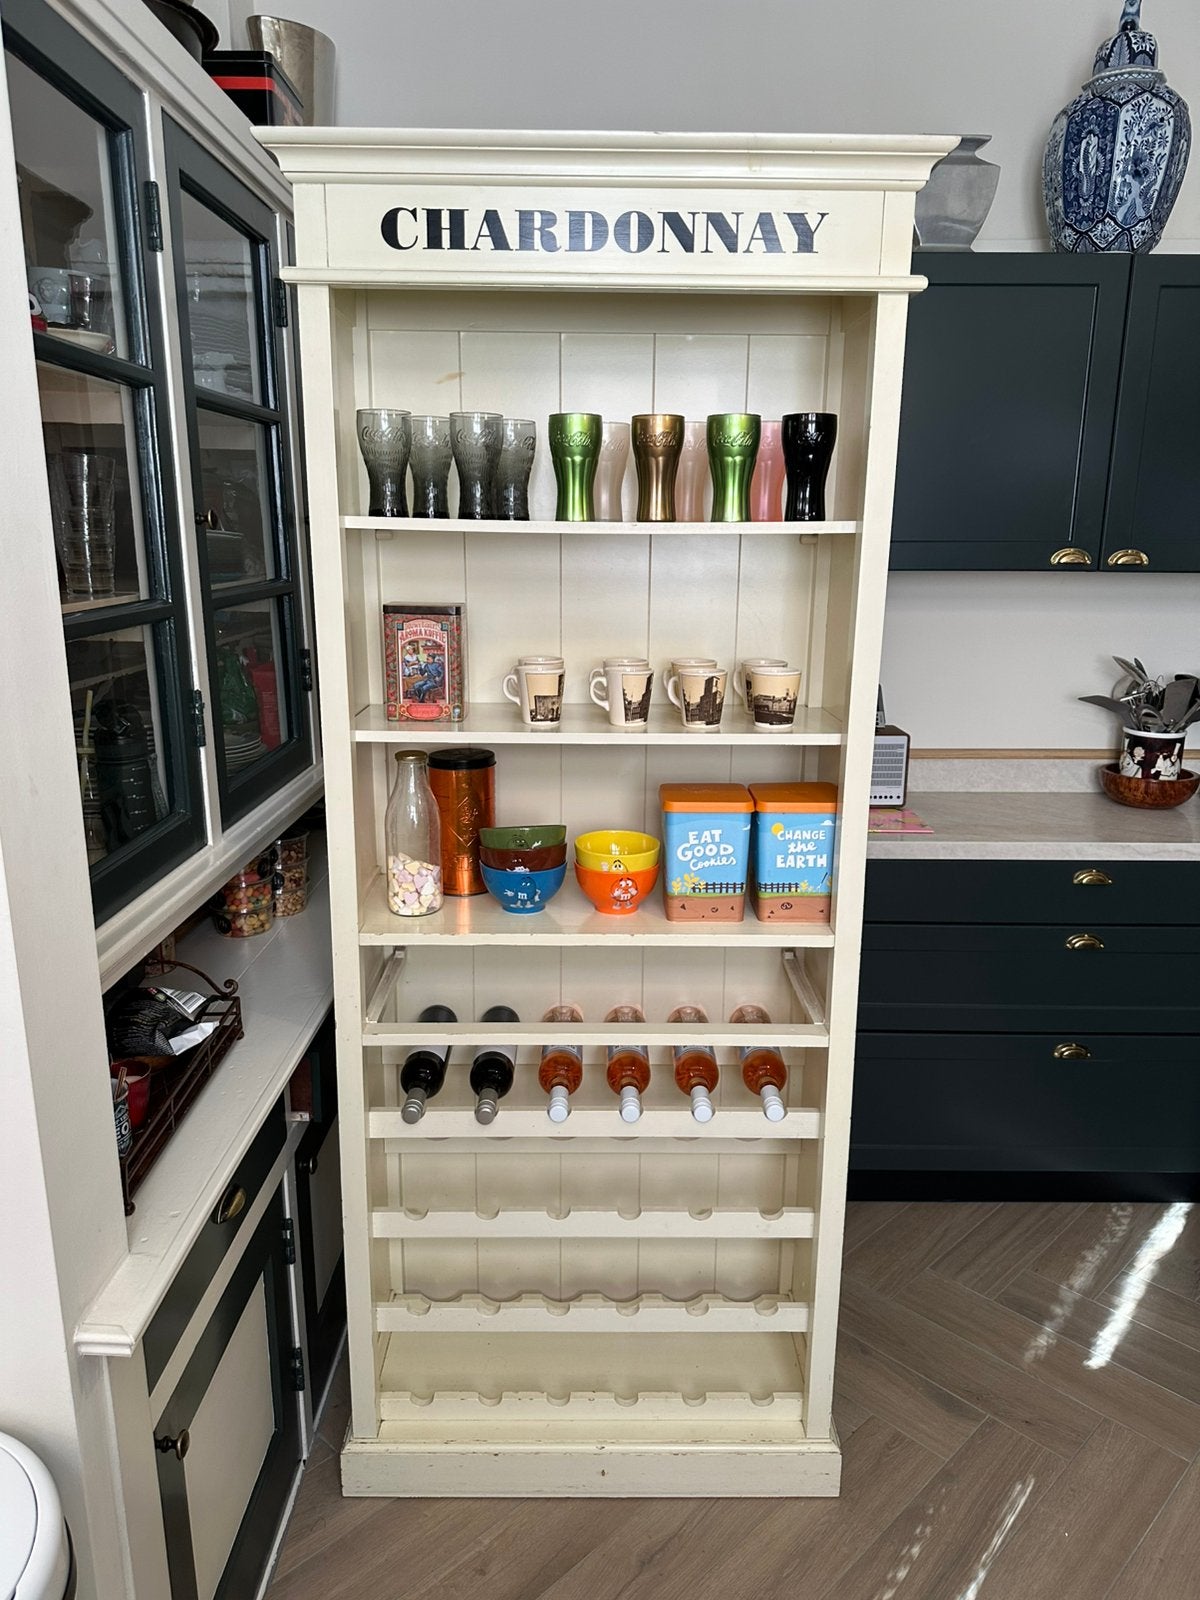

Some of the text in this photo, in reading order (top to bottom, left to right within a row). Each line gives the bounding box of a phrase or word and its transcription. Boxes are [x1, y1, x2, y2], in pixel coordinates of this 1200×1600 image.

[380, 206, 829, 254] CHARDONNAY
[688, 829, 723, 845] EAT
[777, 830, 826, 842] CHANGE
[676, 843, 734, 862] GOOD
[787, 841, 818, 853] the
[689, 856, 737, 871] Cookies
[776, 853, 828, 869] EARTH
